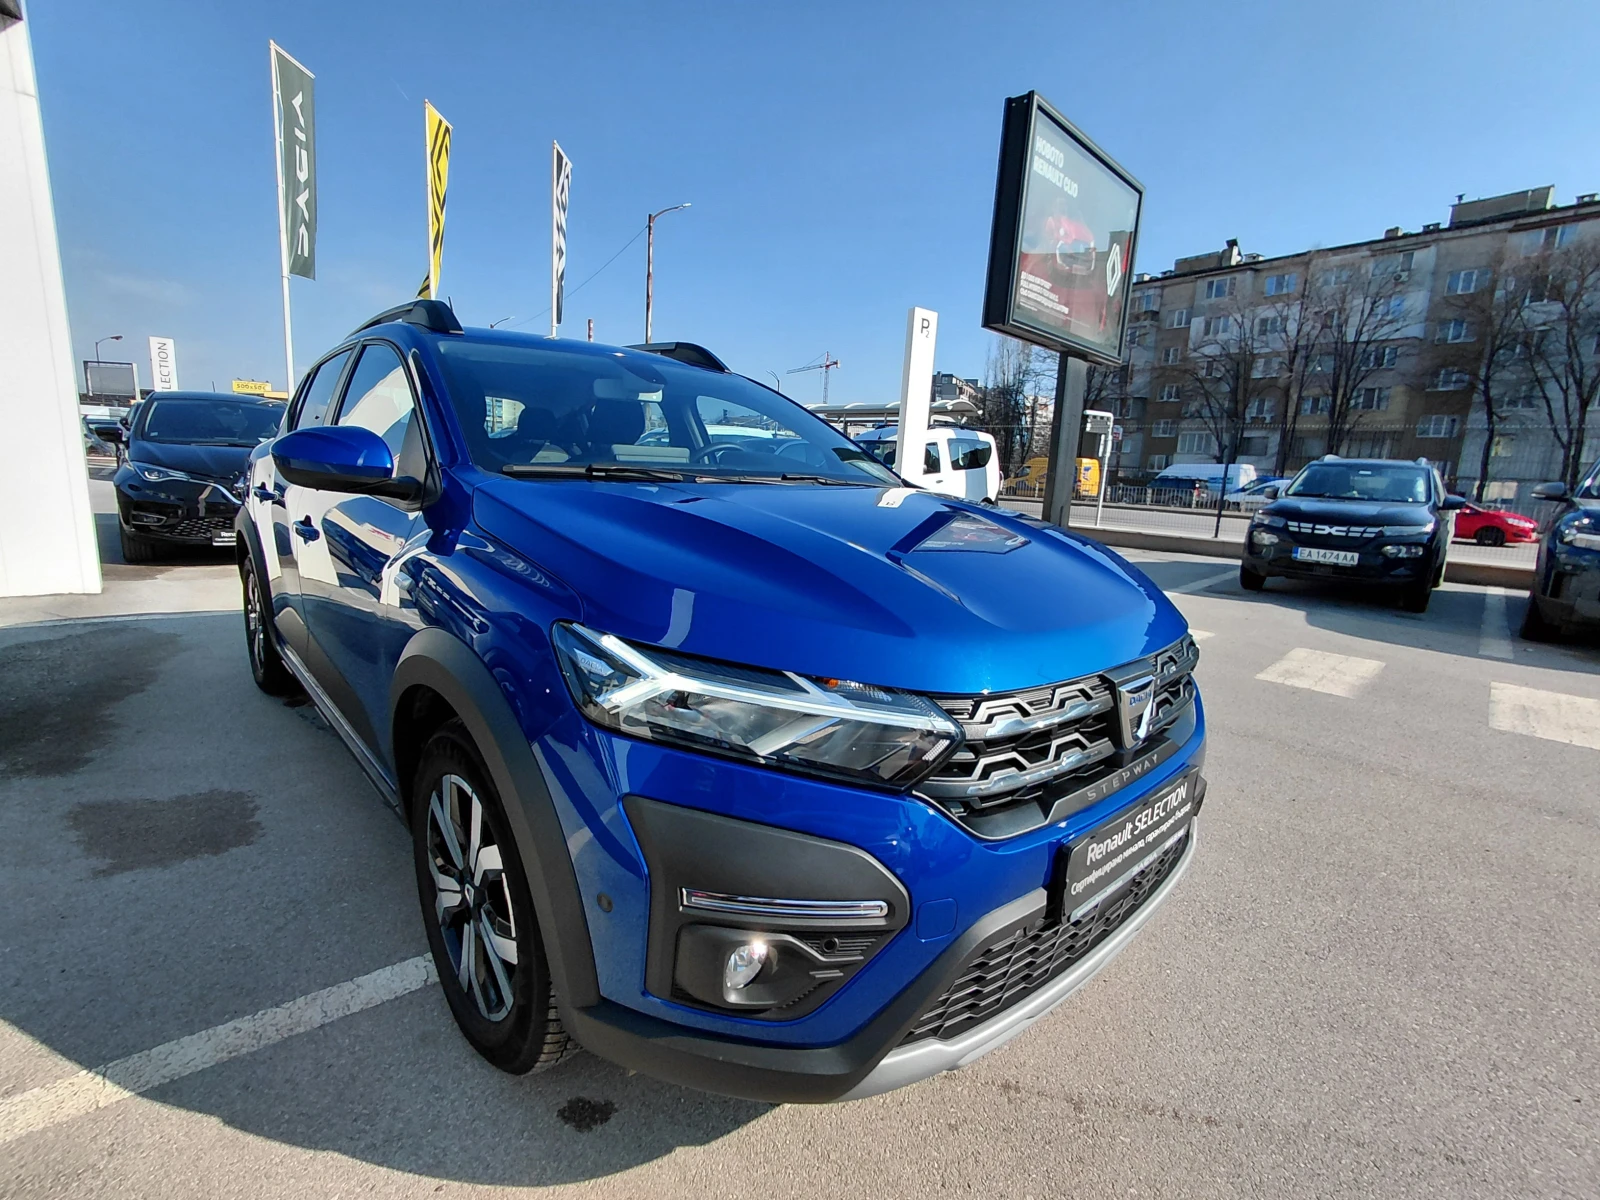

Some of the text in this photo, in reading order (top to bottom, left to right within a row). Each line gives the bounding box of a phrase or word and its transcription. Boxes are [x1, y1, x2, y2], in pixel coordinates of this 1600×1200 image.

[291, 90, 309, 258] DACIA
[1063, 176, 1079, 199] CLIO
[156, 341, 172, 391] LECTION
[1316, 551, 1340, 562] 1474
[1341, 553, 1356, 563] AA
[1086, 753, 1158, 801] STEPWAY
[1086, 821, 1133, 866] Renault
[1133, 782, 1188, 835] SELECTION
